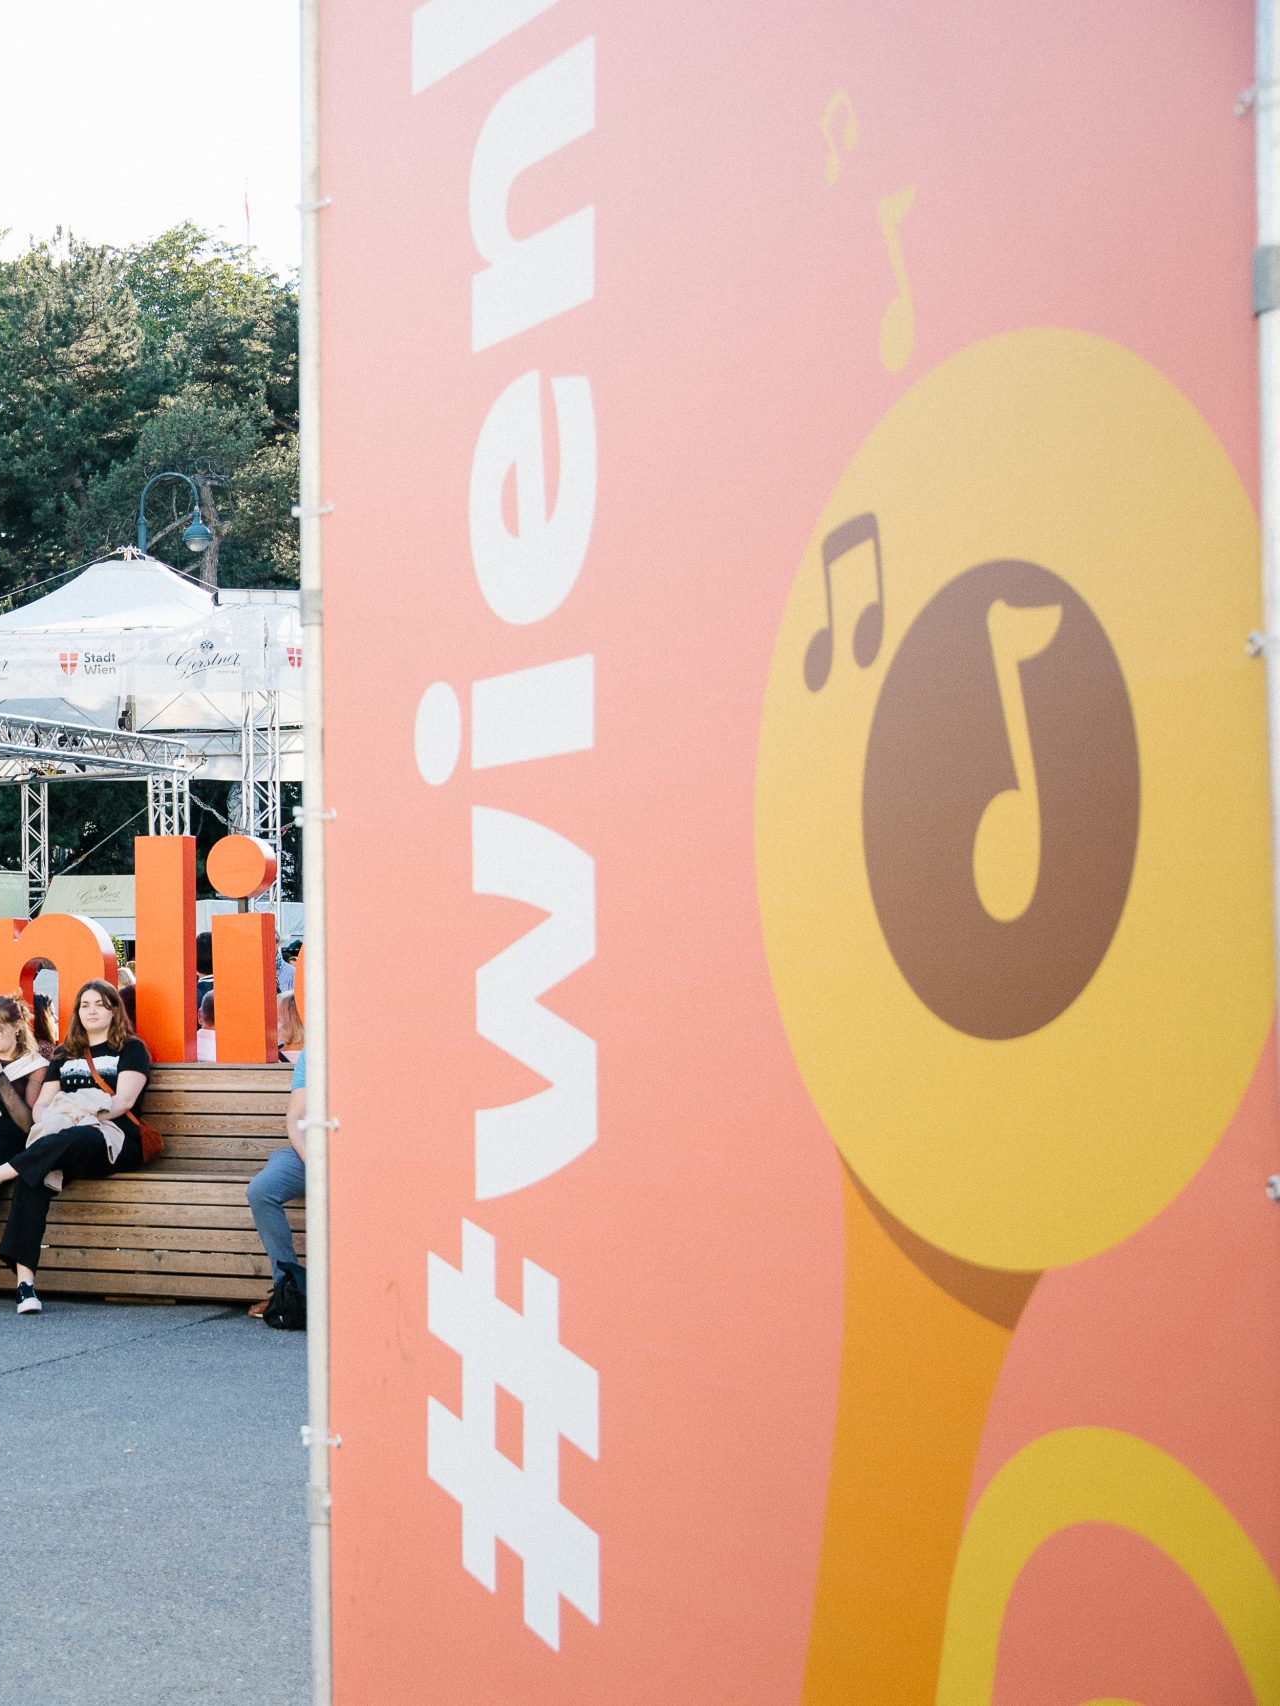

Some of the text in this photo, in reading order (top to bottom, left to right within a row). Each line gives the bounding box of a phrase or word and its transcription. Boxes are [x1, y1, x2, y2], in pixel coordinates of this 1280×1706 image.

[84, 652, 116, 663] Stadt
[84, 664, 117, 675] Wien
[166, 648, 241, 680] Gerstner
